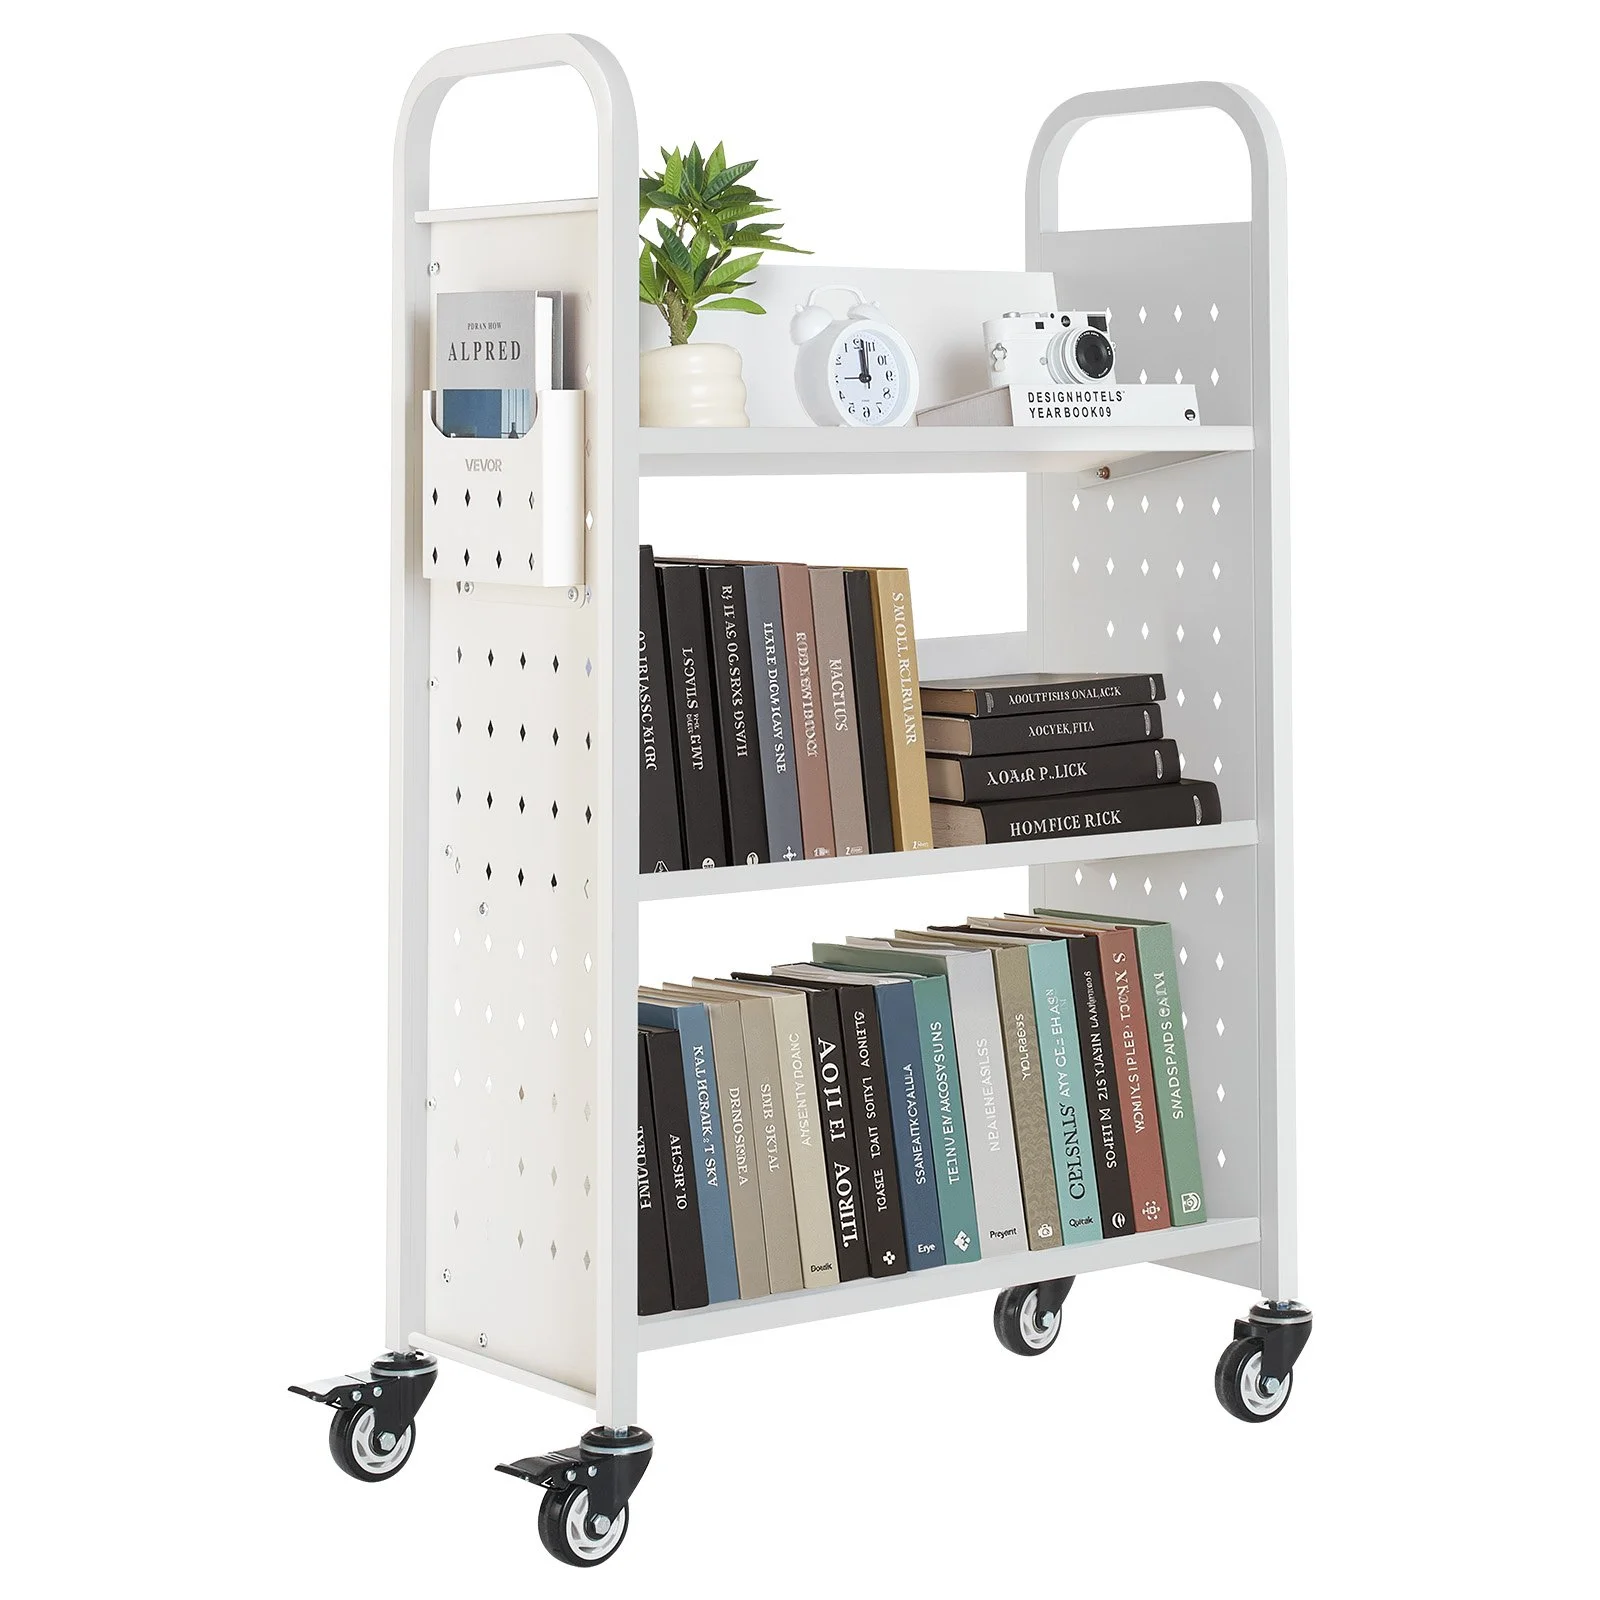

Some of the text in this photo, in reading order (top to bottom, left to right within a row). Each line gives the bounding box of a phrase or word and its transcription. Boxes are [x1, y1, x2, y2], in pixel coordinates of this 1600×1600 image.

[448, 340, 522, 361] ALPRED
[464, 458, 503, 472] VEVOR
[1084, 810, 1122, 828] RICK
